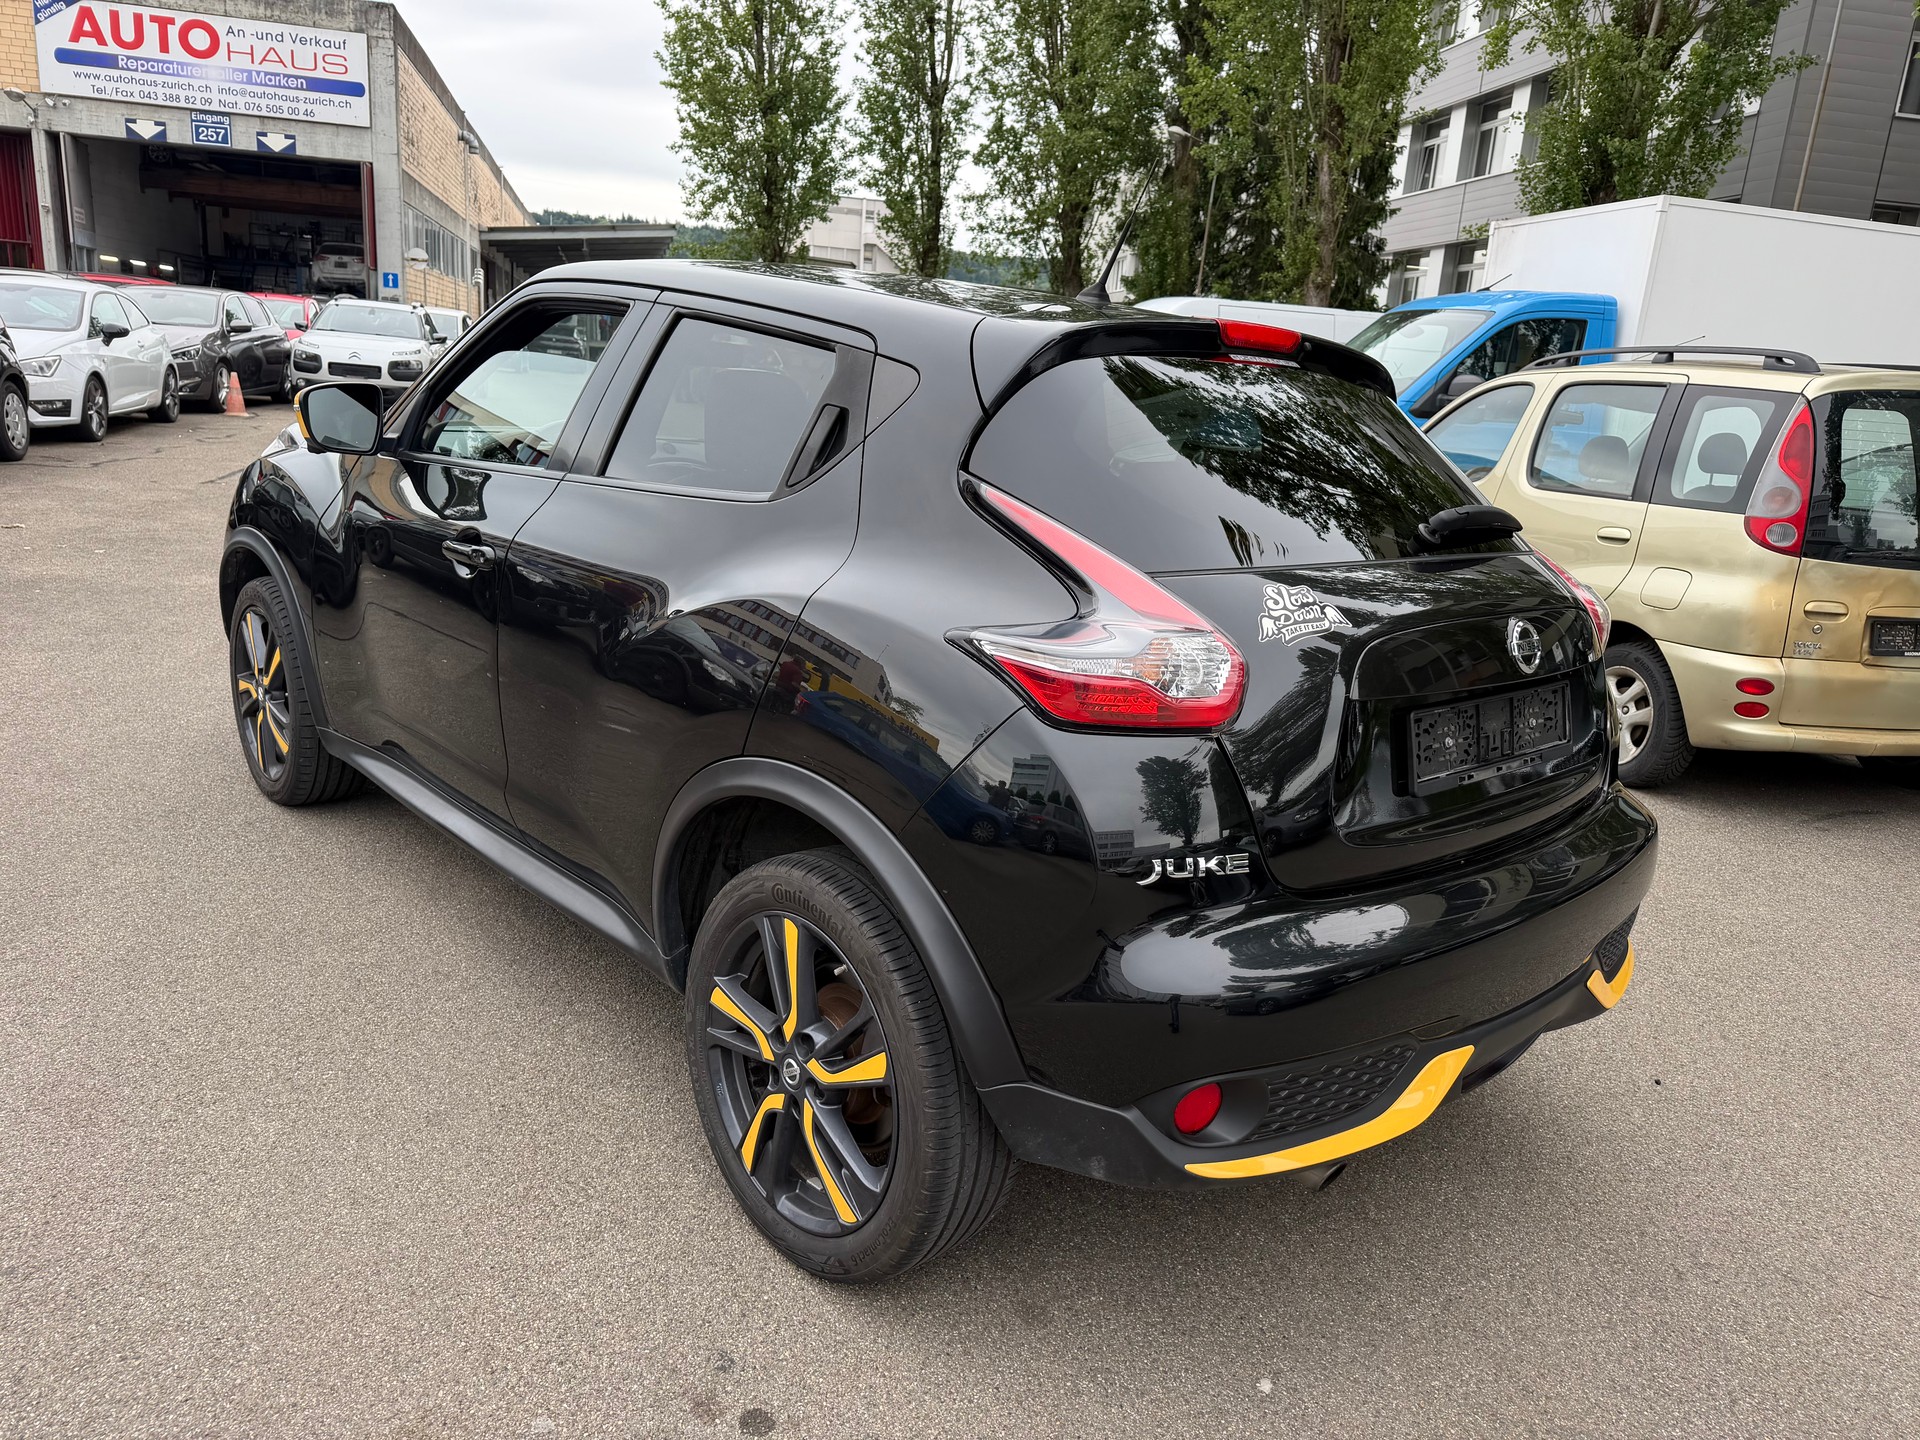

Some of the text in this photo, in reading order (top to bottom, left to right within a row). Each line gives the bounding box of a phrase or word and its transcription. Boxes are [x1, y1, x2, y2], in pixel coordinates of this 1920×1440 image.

[34, 0, 52, 8] Hie
[36, 1, 67, 21] günstig
[68, 5, 221, 60] AUTO
[226, 25, 246, 38] An
[289, 32, 347, 50] Verkauf
[226, 42, 349, 75] HAUS
[73, 70, 352, 109] www.autohaus-zurich.ch info@autohaus-zurich.ch
[252, 71, 307, 90] Marken
[91, 84, 316, 118] Tel./Fax 043 388 82 09 Nat. 076 505 00 46
[191, 111, 230, 125] Eingang
[198, 127, 225, 142] 257
[1265, 585, 1314, 611] Slow
[1268, 604, 1325, 628] Down
[1285, 622, 1327, 637] TAKE IT EASY
[1136, 853, 1250, 886] JUKE
[771, 882, 846, 938] Continental
